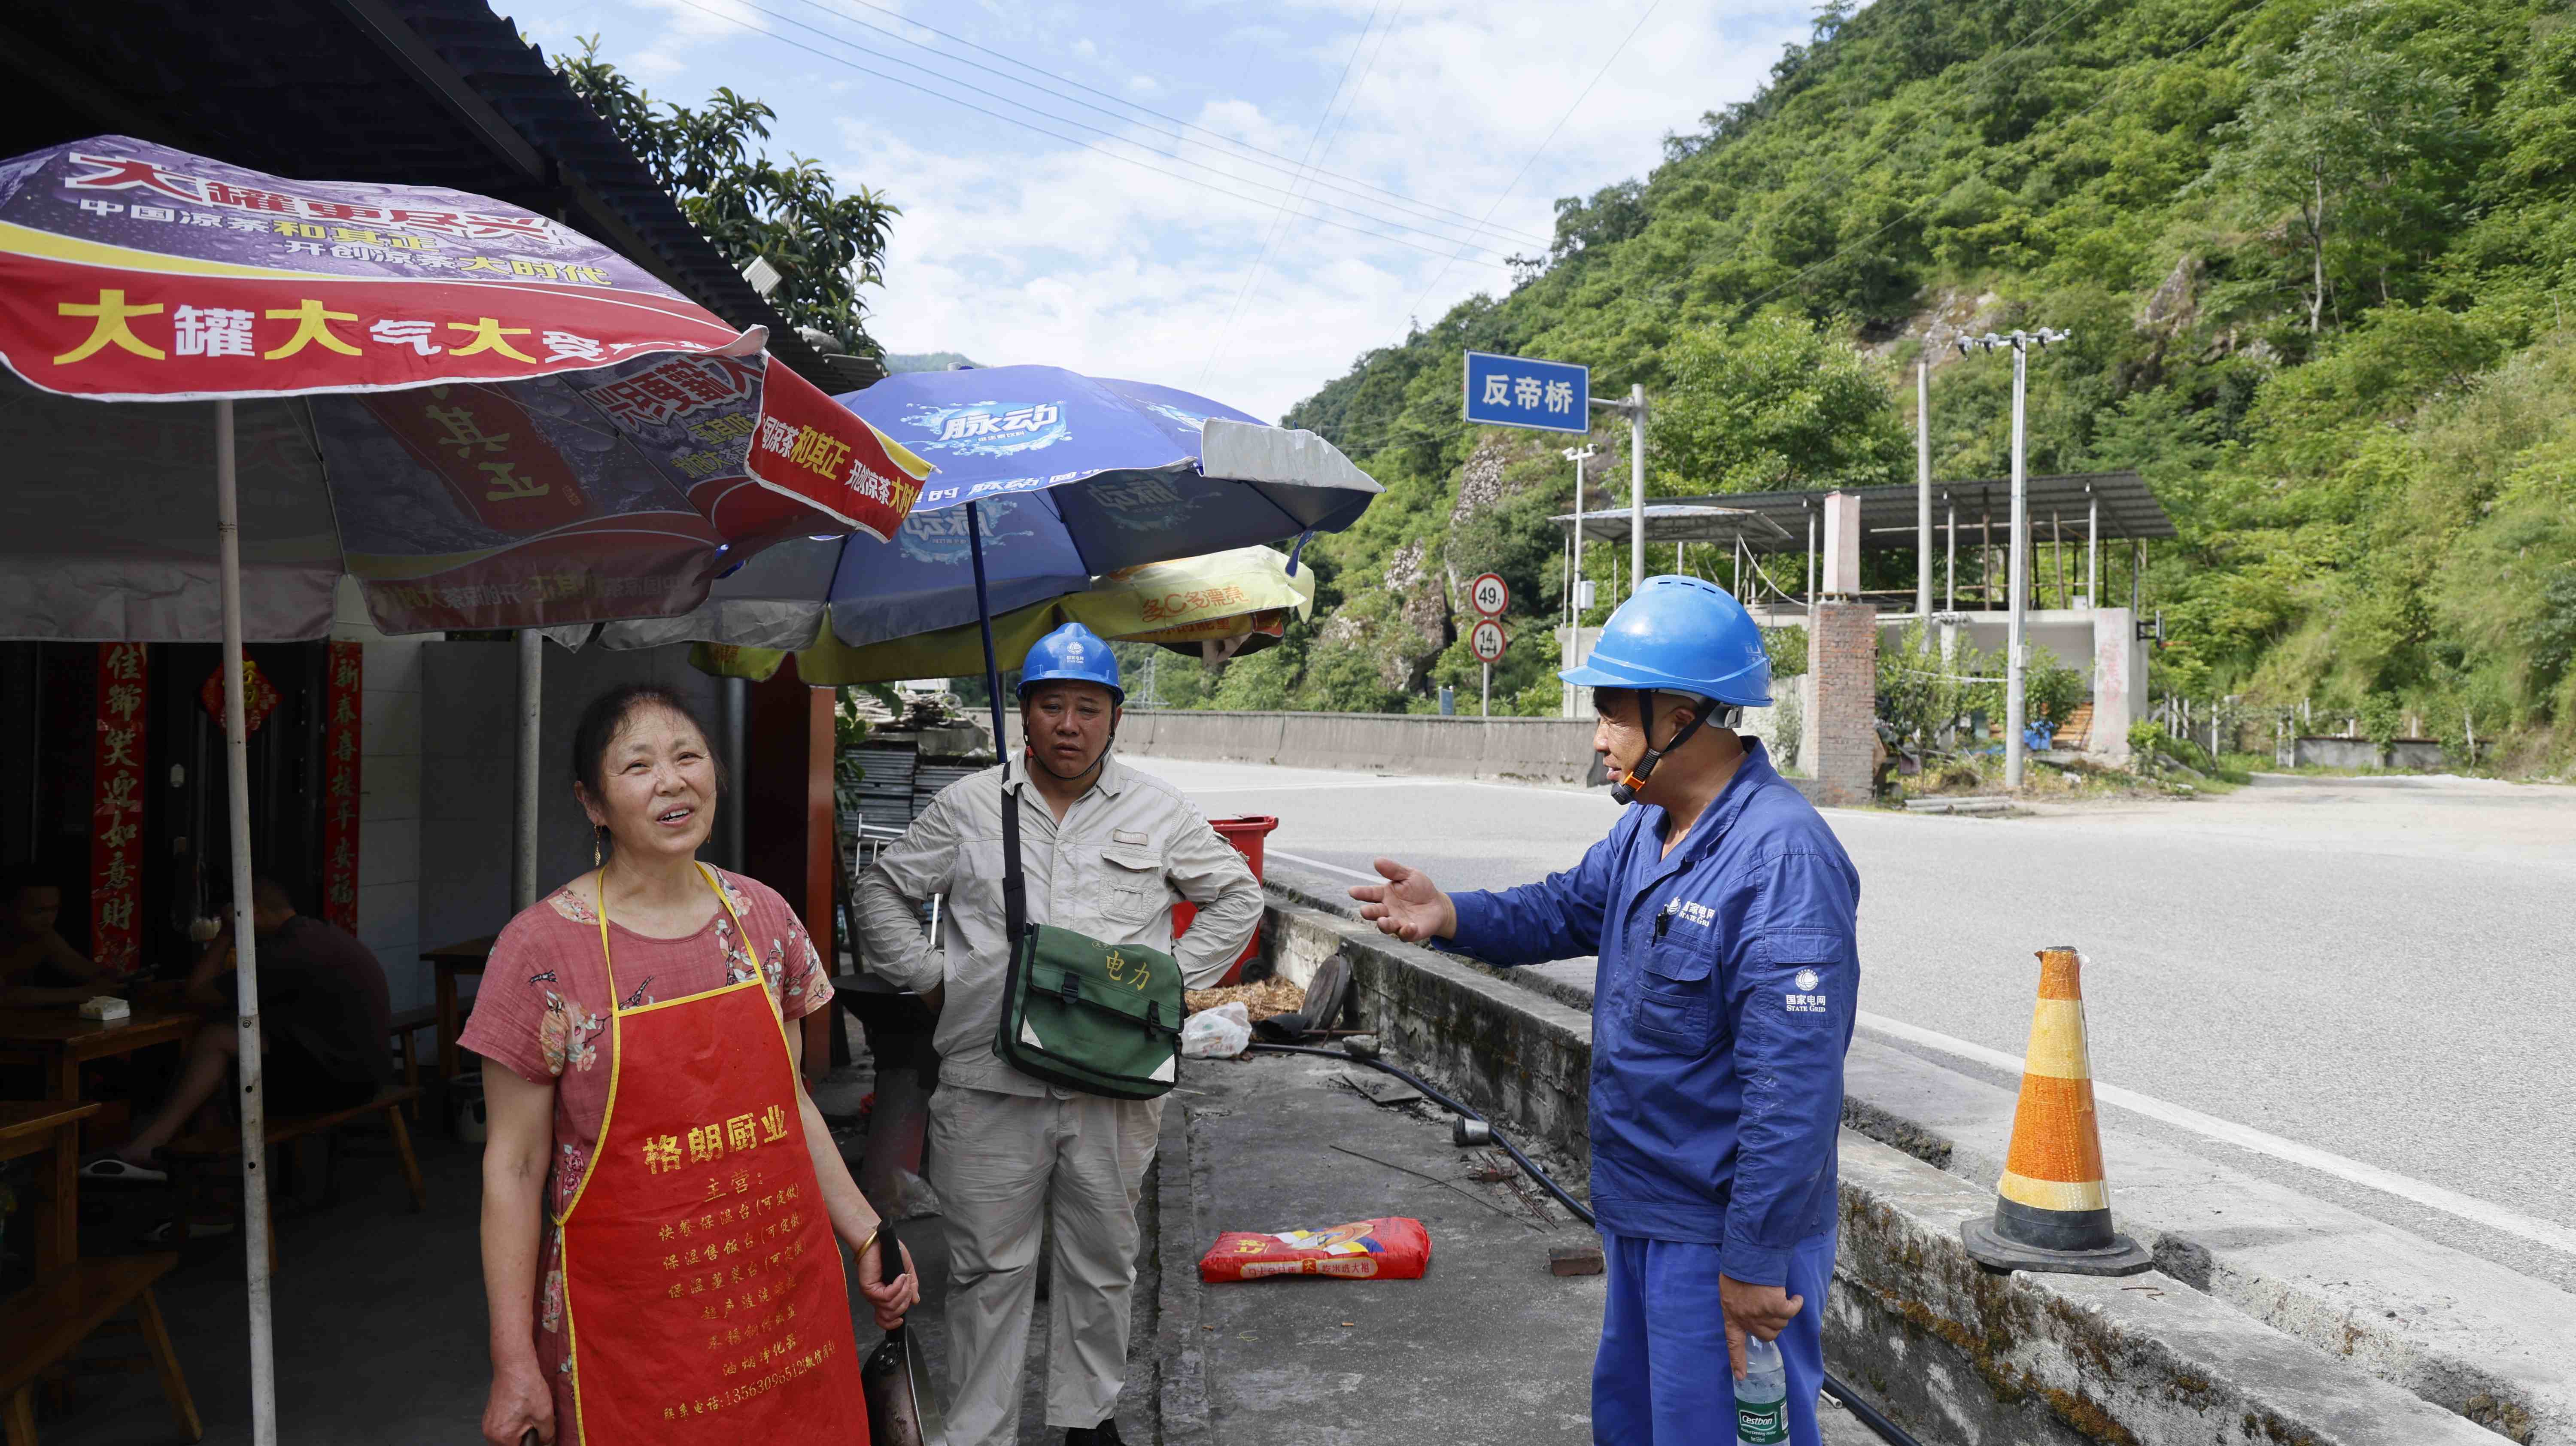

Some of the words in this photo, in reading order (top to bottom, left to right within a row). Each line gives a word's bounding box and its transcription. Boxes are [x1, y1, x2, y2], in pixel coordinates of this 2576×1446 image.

[80, 198, 440, 252] 中国凉茶和其正
[282, 240, 612, 285] 开创凉茶大时代
[53, 289, 711, 365] 大罐大气大受
[1482, 374, 1573, 413] 反帝桥
[937, 404, 1059, 441] 脉动
[762, 412, 851, 480] 国凉茶和其正
[1142, 585, 1250, 623] 多C多漂亮
[1679, 911, 1697, 922] STATE
[1106, 950, 1150, 990] 电力
[1786, 994, 1826, 1006] 国家电网
[642, 1104, 787, 1174] 格朗厨业
